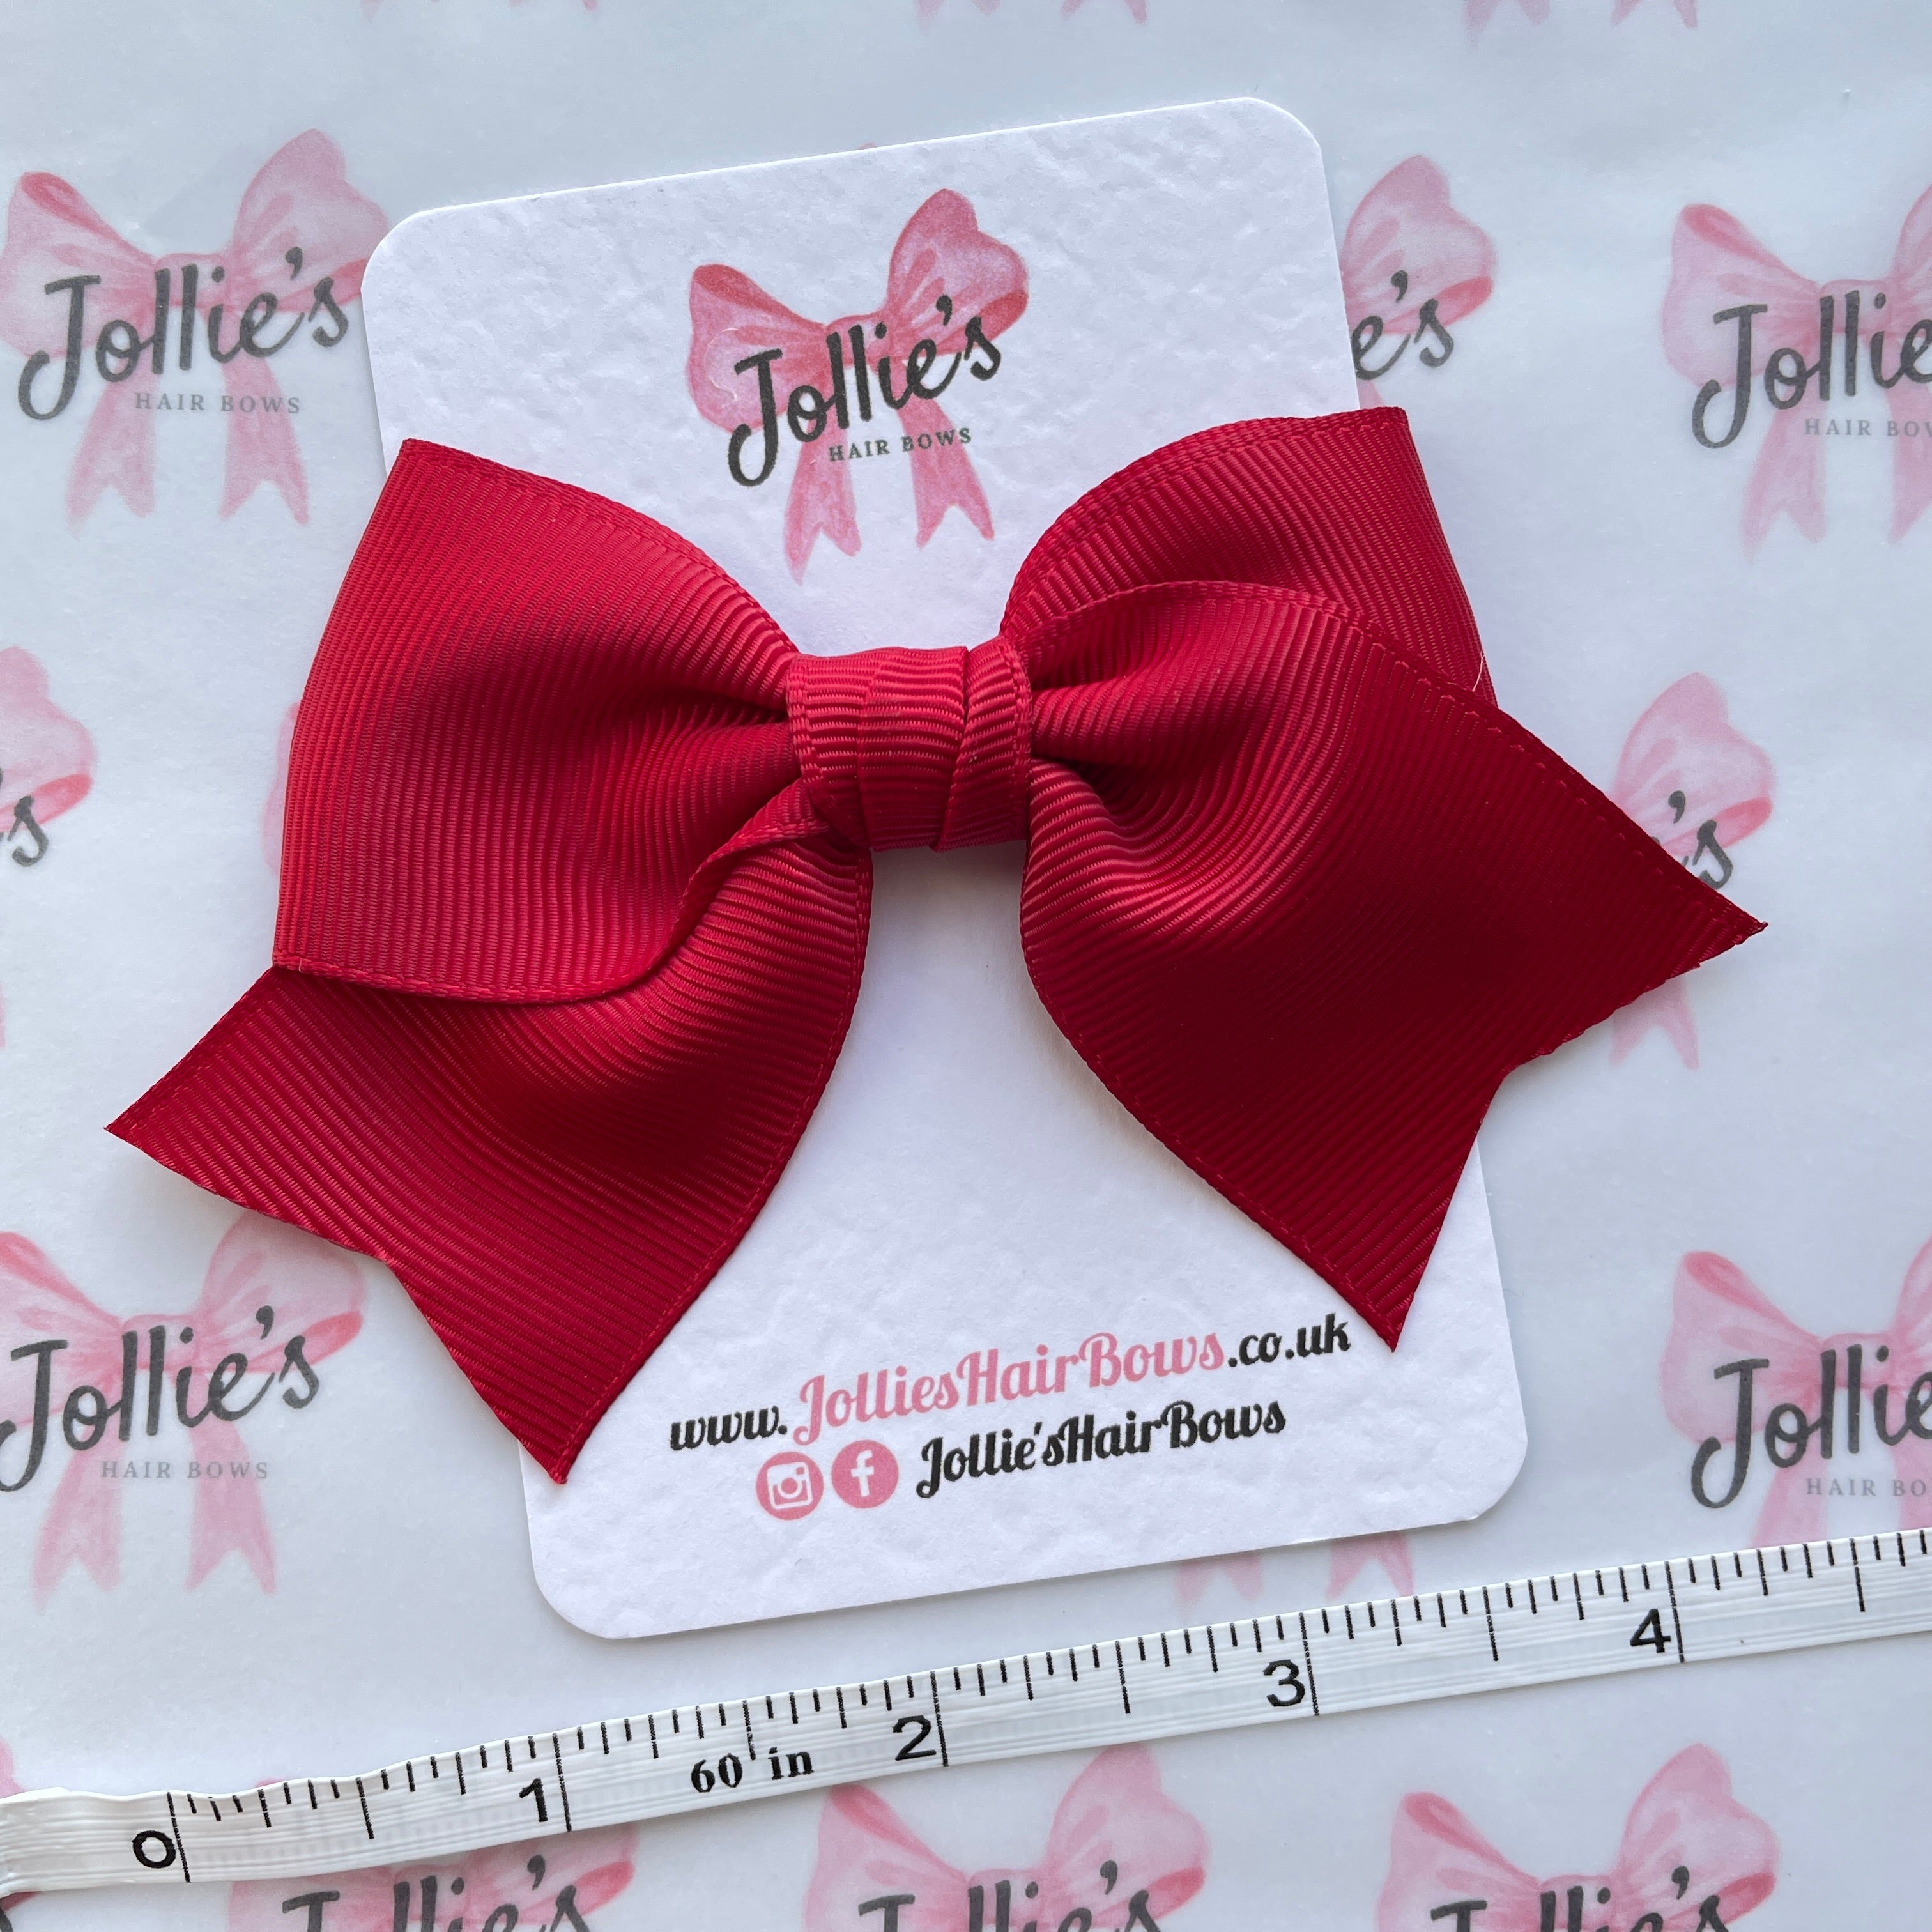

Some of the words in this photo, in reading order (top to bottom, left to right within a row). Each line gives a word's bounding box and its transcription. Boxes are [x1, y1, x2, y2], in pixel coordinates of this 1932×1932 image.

[19, 247, 348, 420] Jollie's
[134, 393, 203, 410] HAIR
[221, 395, 298, 413] BOWS
[728, 295, 1001, 486] Jollie's
[829, 440, 889, 461] HAIR
[902, 429, 970, 451] BOWS
[1805, 419, 1869, 435] HAIR
[0, 1306, 318, 1492] Jollie's
[670, 1314, 1351, 1450] www.JolliesHairBows.co.uk
[102, 1460, 169, 1478] HAIR
[188, 1462, 266, 1478] BOWS
[916, 1400, 1285, 1498] Jollie'sHairBows
[1806, 1478, 1875, 1495] HAIR
[132, 1830, 176, 1869] 0
[519, 1779, 548, 1822] 1
[893, 1715, 936, 1761] 2
[1263, 1660, 1305, 1707] 3
[1630, 1609, 1671, 1653] 4
[691, 1754, 742, 1793] 60
[768, 1747, 814, 1780] in
